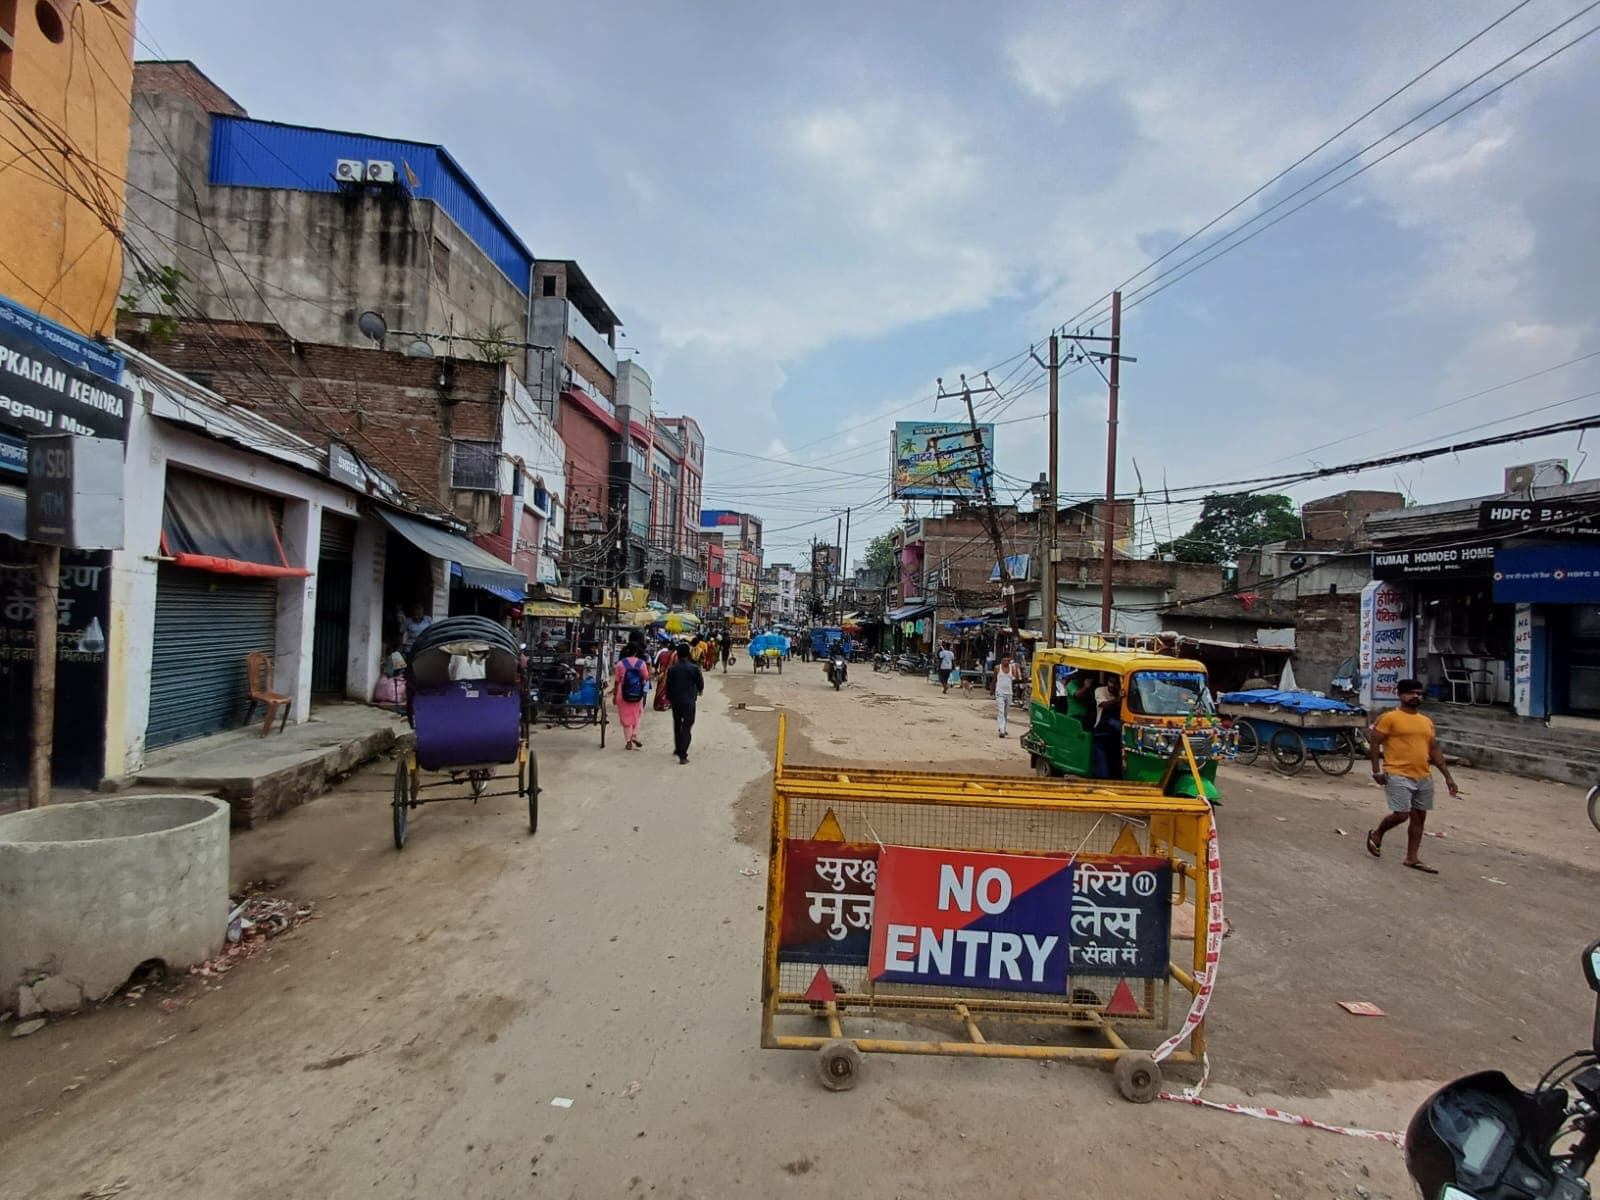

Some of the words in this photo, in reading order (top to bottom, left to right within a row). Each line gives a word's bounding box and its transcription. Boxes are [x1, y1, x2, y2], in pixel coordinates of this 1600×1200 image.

[69, 378, 124, 418] KENDRA
[1490, 507, 1532, 521] HDFC
[1375, 554, 1409, 566] KUMAR
[1461, 546, 1495, 560] HOME
[938, 863, 1013, 915] NO
[884, 924, 1059, 982] ENTRY
